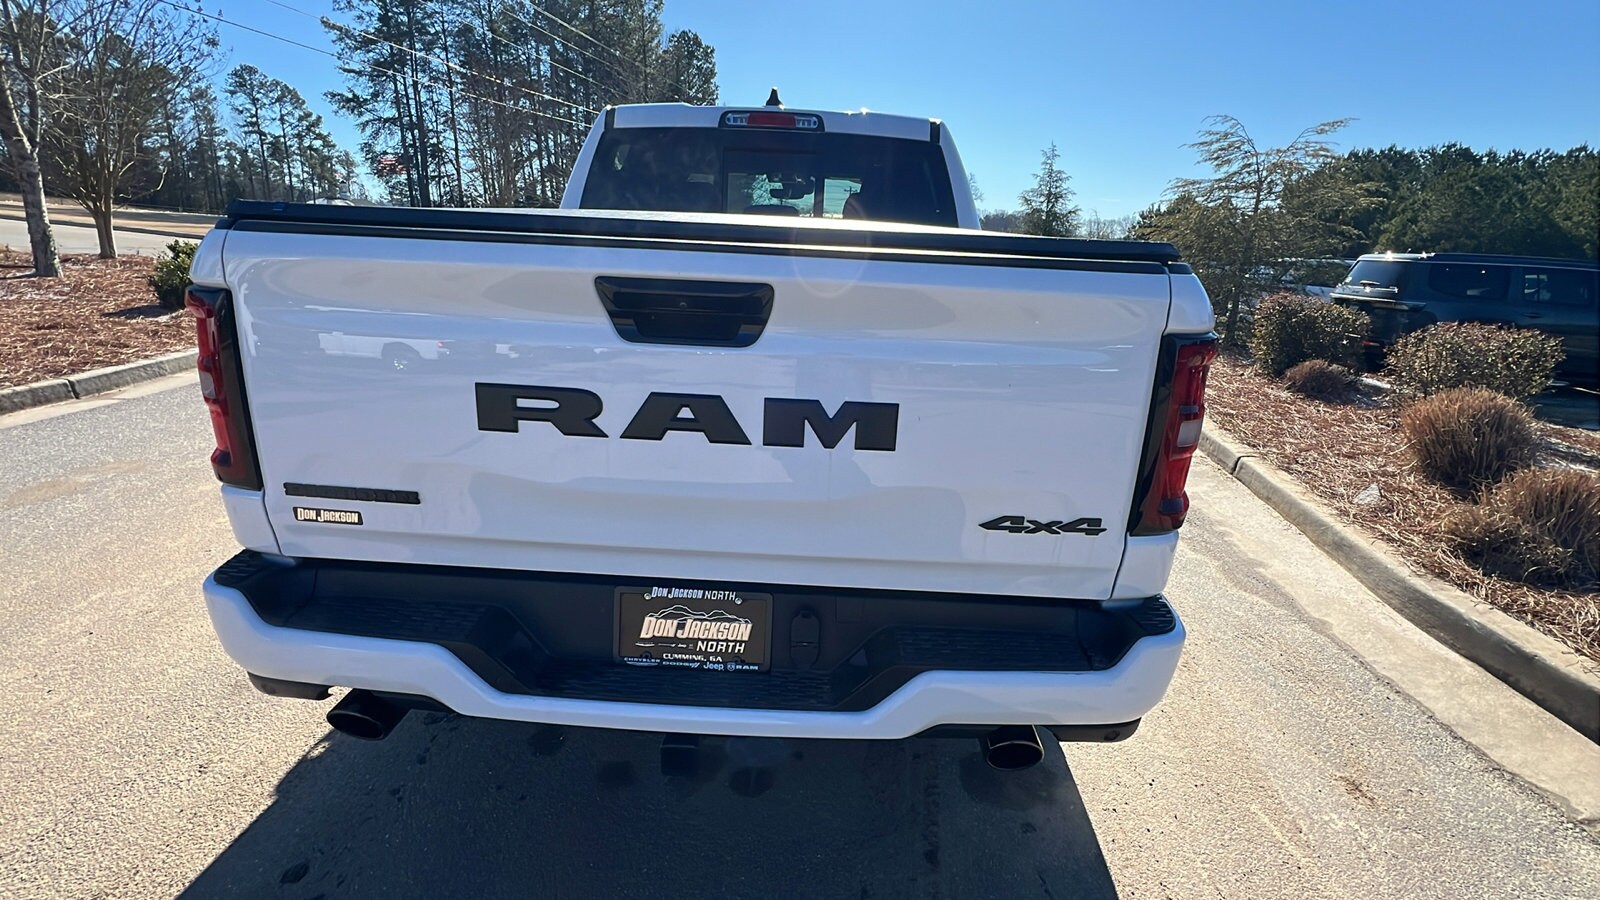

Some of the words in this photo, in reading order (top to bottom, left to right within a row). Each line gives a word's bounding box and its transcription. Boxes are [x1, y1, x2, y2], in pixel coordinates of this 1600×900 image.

[474, 382, 900, 451] RAM
[297, 508, 317, 521] DON
[318, 509, 359, 523] JACKSON
[978, 515, 1107, 536] 4x4
[651, 586, 667, 598] DON
[668, 587, 703, 599] JACKSON
[704, 590, 736, 601] NORTH
[639, 616, 678, 639] DON
[676, 617, 753, 641] JACKSON
[696, 640, 745, 653] NORTH
[663, 653, 707, 662] CUMMING,
[703, 661, 724, 671] Jeep
